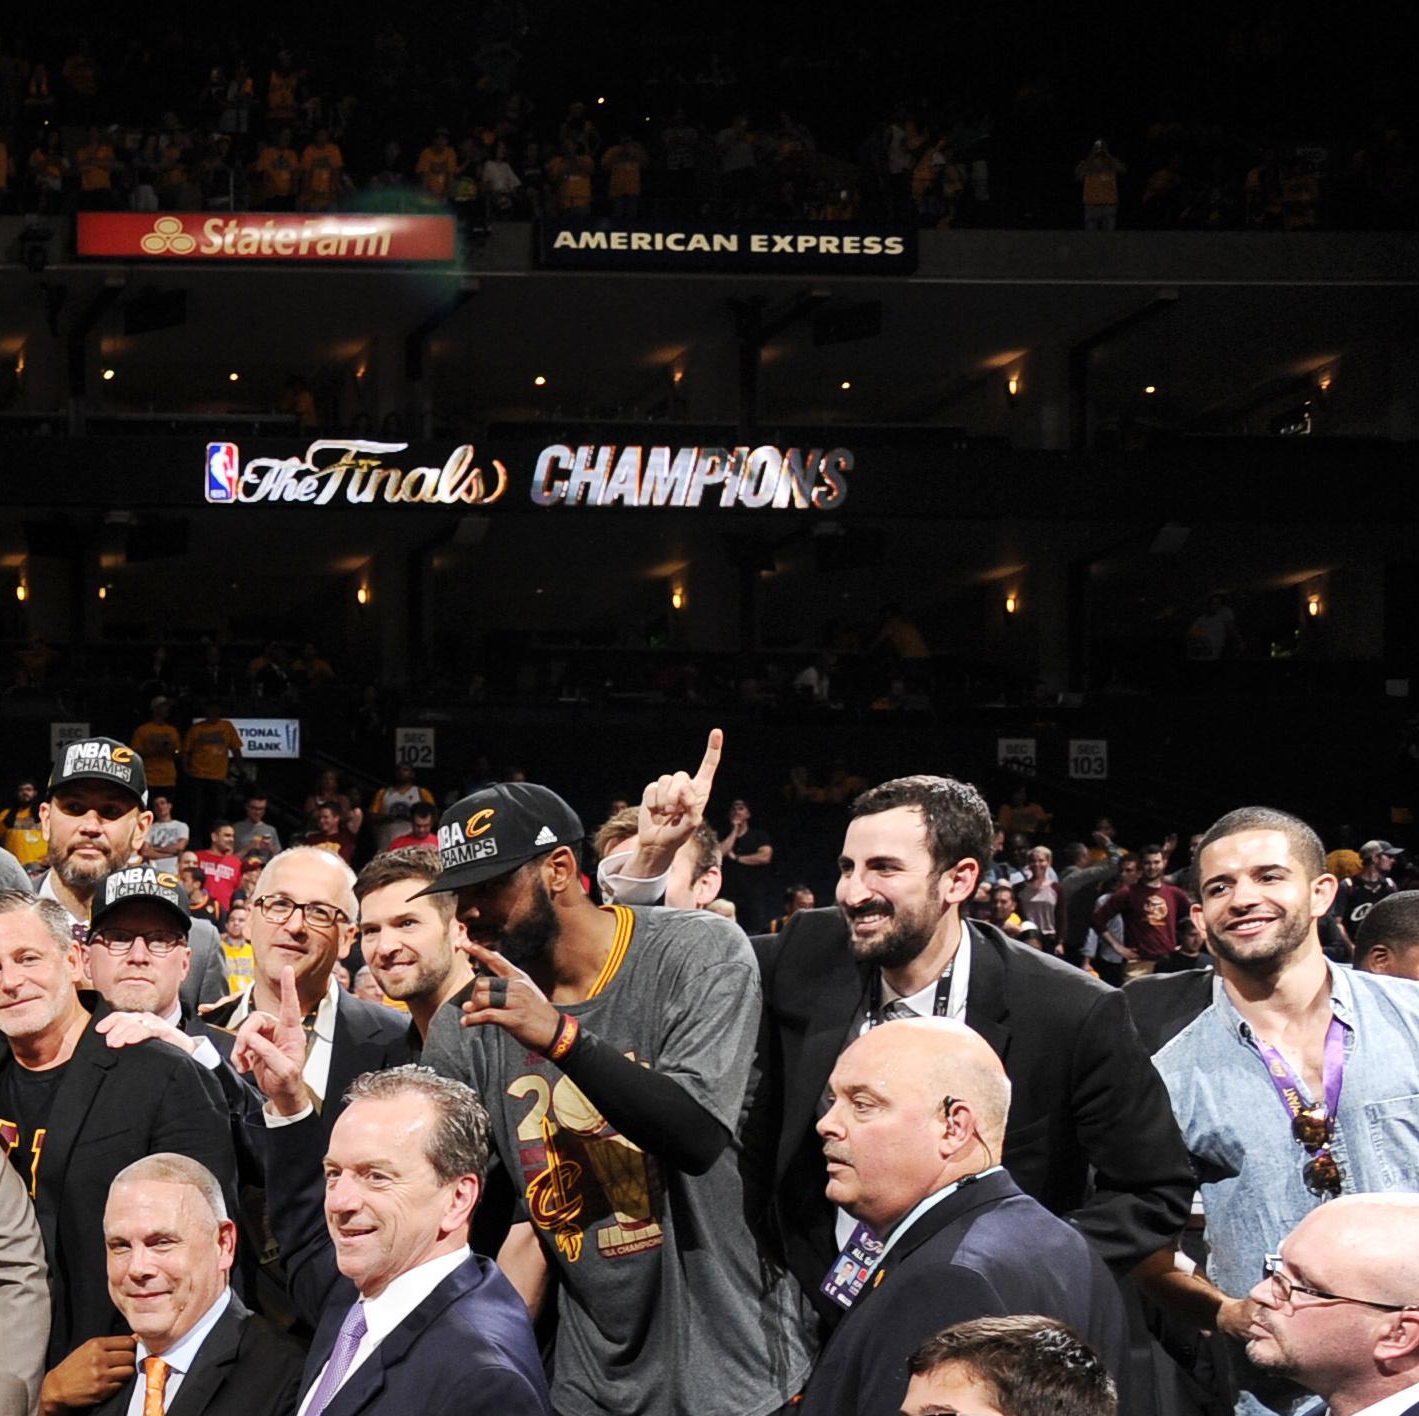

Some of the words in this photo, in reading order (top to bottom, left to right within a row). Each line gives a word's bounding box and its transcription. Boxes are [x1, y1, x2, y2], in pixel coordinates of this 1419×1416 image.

[554, 231, 738, 252] AMERICAN
[751, 233, 905, 255] EXPRESS
[235, 456, 316, 503] The
[304, 439, 508, 505] Finals
[530, 444, 855, 510] CHAMPIONS
[404, 734, 426, 743] SEC
[74, 743, 112, 760] NBA
[398, 746, 432, 764] 102
[73, 758, 132, 783] CHAMPS
[1072, 756, 1104, 775] 103
[439, 821, 467, 850] BA
[440, 837, 499, 870] HAMPS
[116, 867, 158, 886] NBA
[1281, 1087, 1304, 1120] YANT
[617, 1237, 664, 1256] CHAMPION
